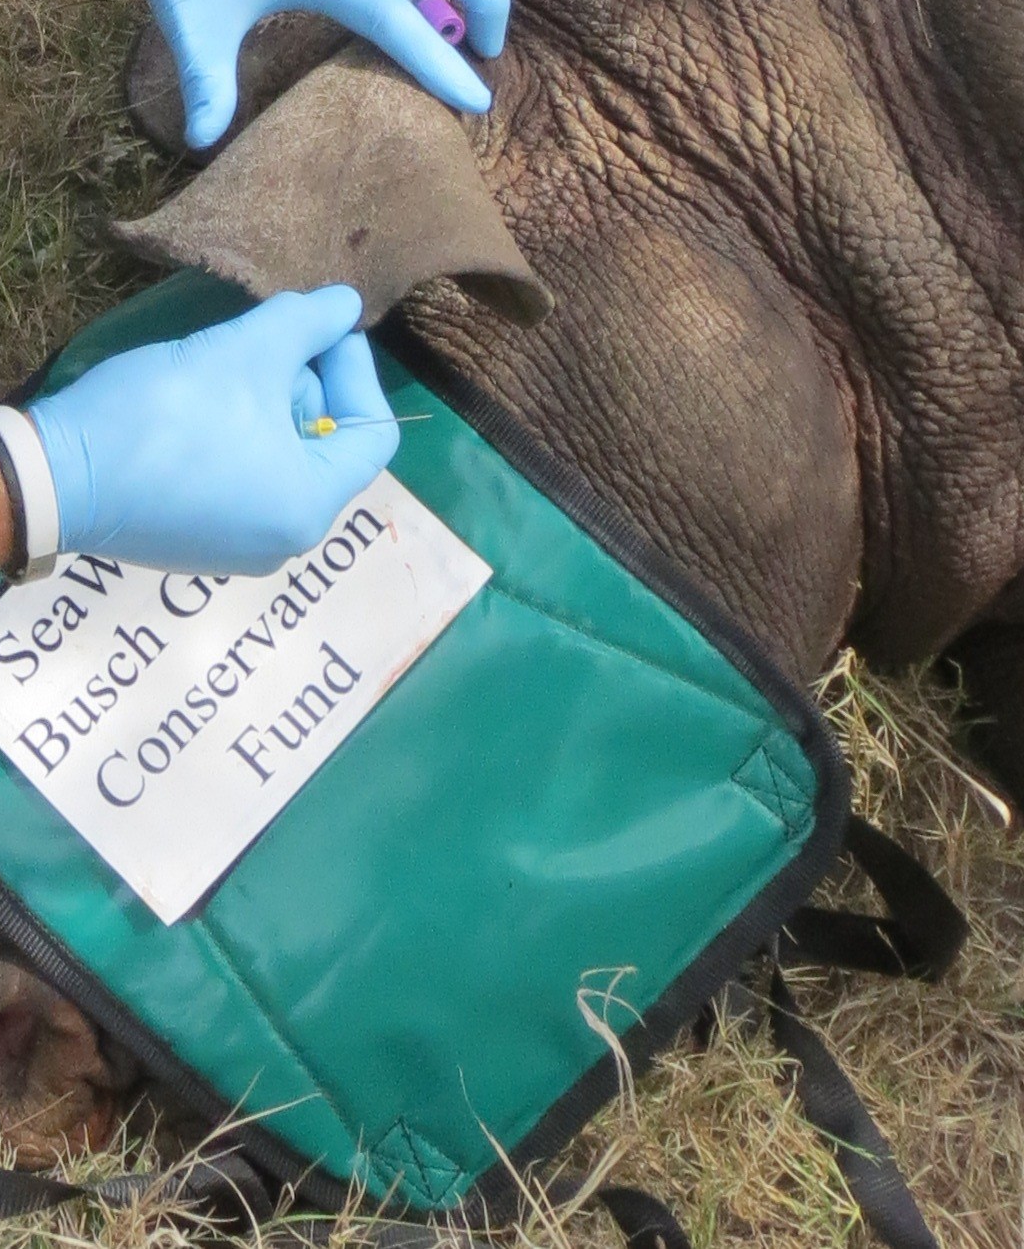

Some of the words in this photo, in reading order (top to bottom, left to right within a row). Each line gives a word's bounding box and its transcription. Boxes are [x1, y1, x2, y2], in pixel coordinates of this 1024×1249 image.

[13, 624, 169, 777] Busch
[96, 504, 387, 809] Conservation
[226, 642, 363, 787] Fund
